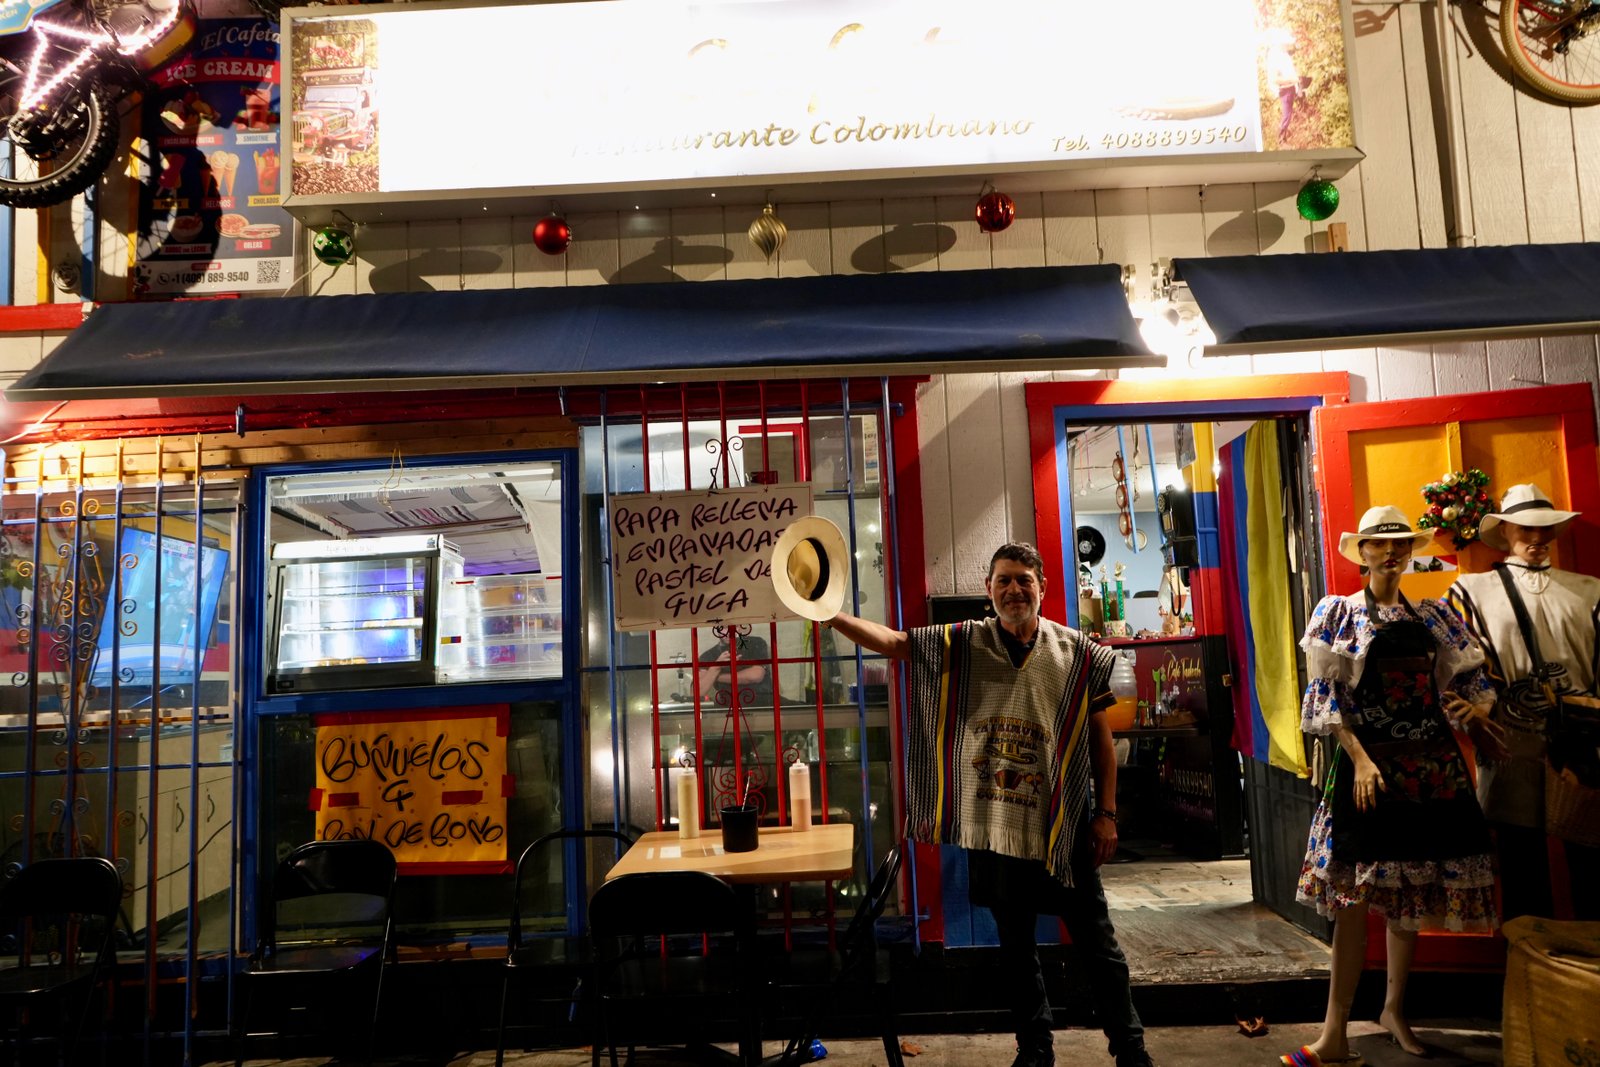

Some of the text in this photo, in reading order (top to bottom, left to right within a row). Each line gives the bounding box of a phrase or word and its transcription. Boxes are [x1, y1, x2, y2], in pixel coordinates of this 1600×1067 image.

[201, 26, 226, 51] El
[166, 60, 273, 82] ICE CREAM
[570, 122, 800, 158] urante
[1052, 125, 1247, 152] Tel. 4088899540
[182, 272, 206, 285] (408)
[207, 271, 249, 283] 889-9540
[614, 497, 798, 537] PAPA RELLENA
[626, 528, 786, 564] EMPANADAS
[635, 559, 772, 596] PASTEL DE
[384, 820, 424, 848] DE
[430, 813, 504, 847] BONO
